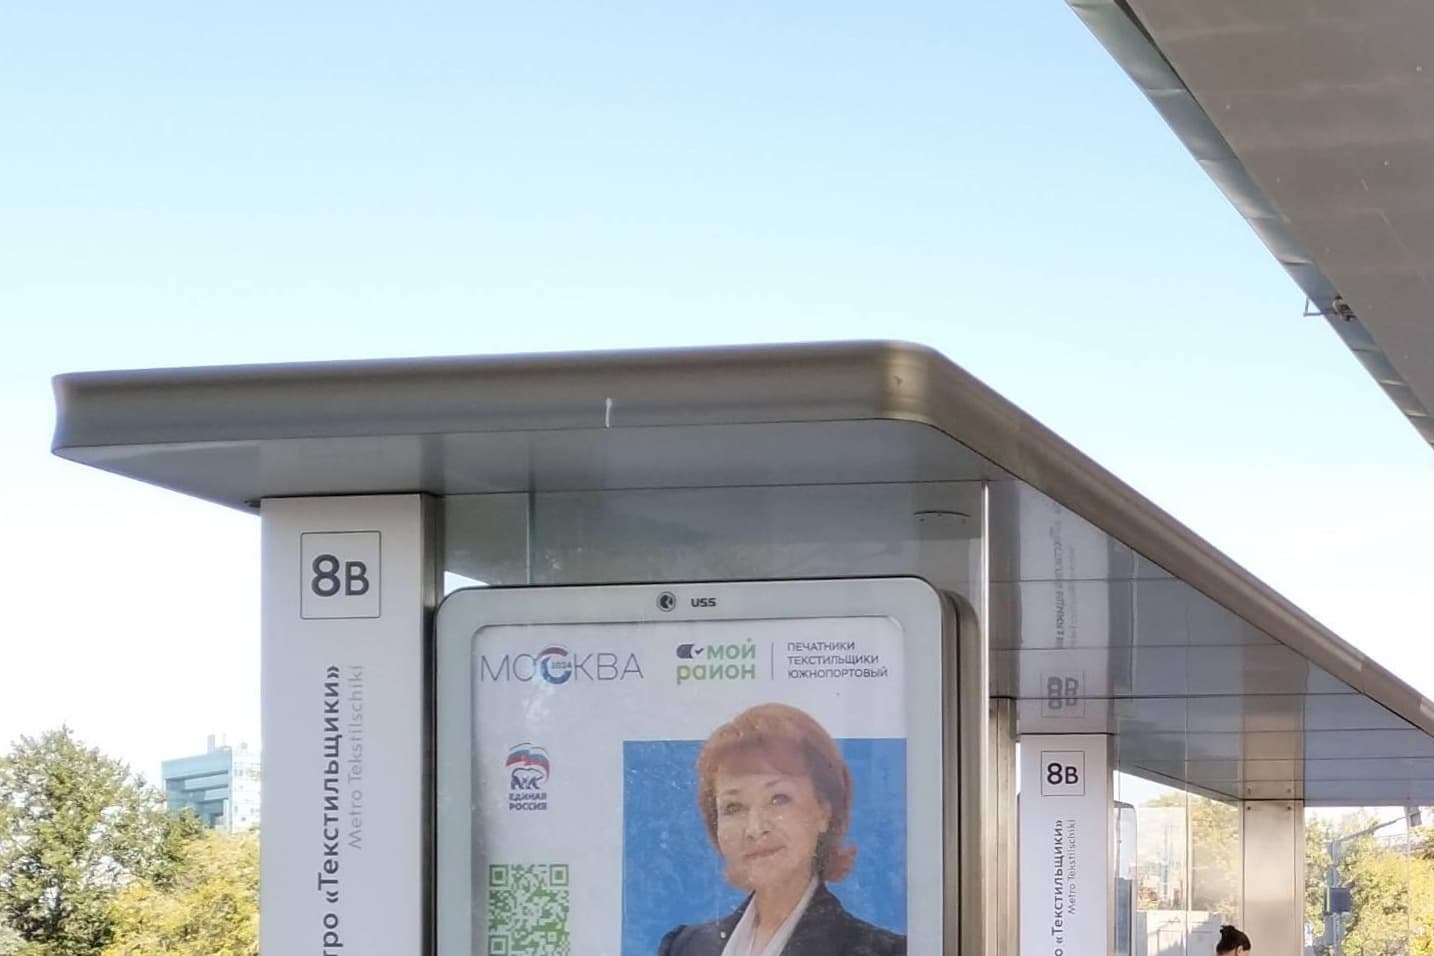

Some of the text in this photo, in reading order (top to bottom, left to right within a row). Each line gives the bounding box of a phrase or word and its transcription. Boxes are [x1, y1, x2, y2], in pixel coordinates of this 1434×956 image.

[690, 597, 717, 608] USS
[787, 641, 856, 652] ПЕЧАТНИКИ
[787, 654, 880, 666] ТЕКСТИЛЬЩИКИ
[787, 666, 889, 680] ЮЖНОПОРТОВЫЙ
[348, 665, 362, 850] Metro Tekstilschiki
[317, 665, 343, 903] «Текстильщики»
[1051, 820, 1065, 943] «Текстильщики»
